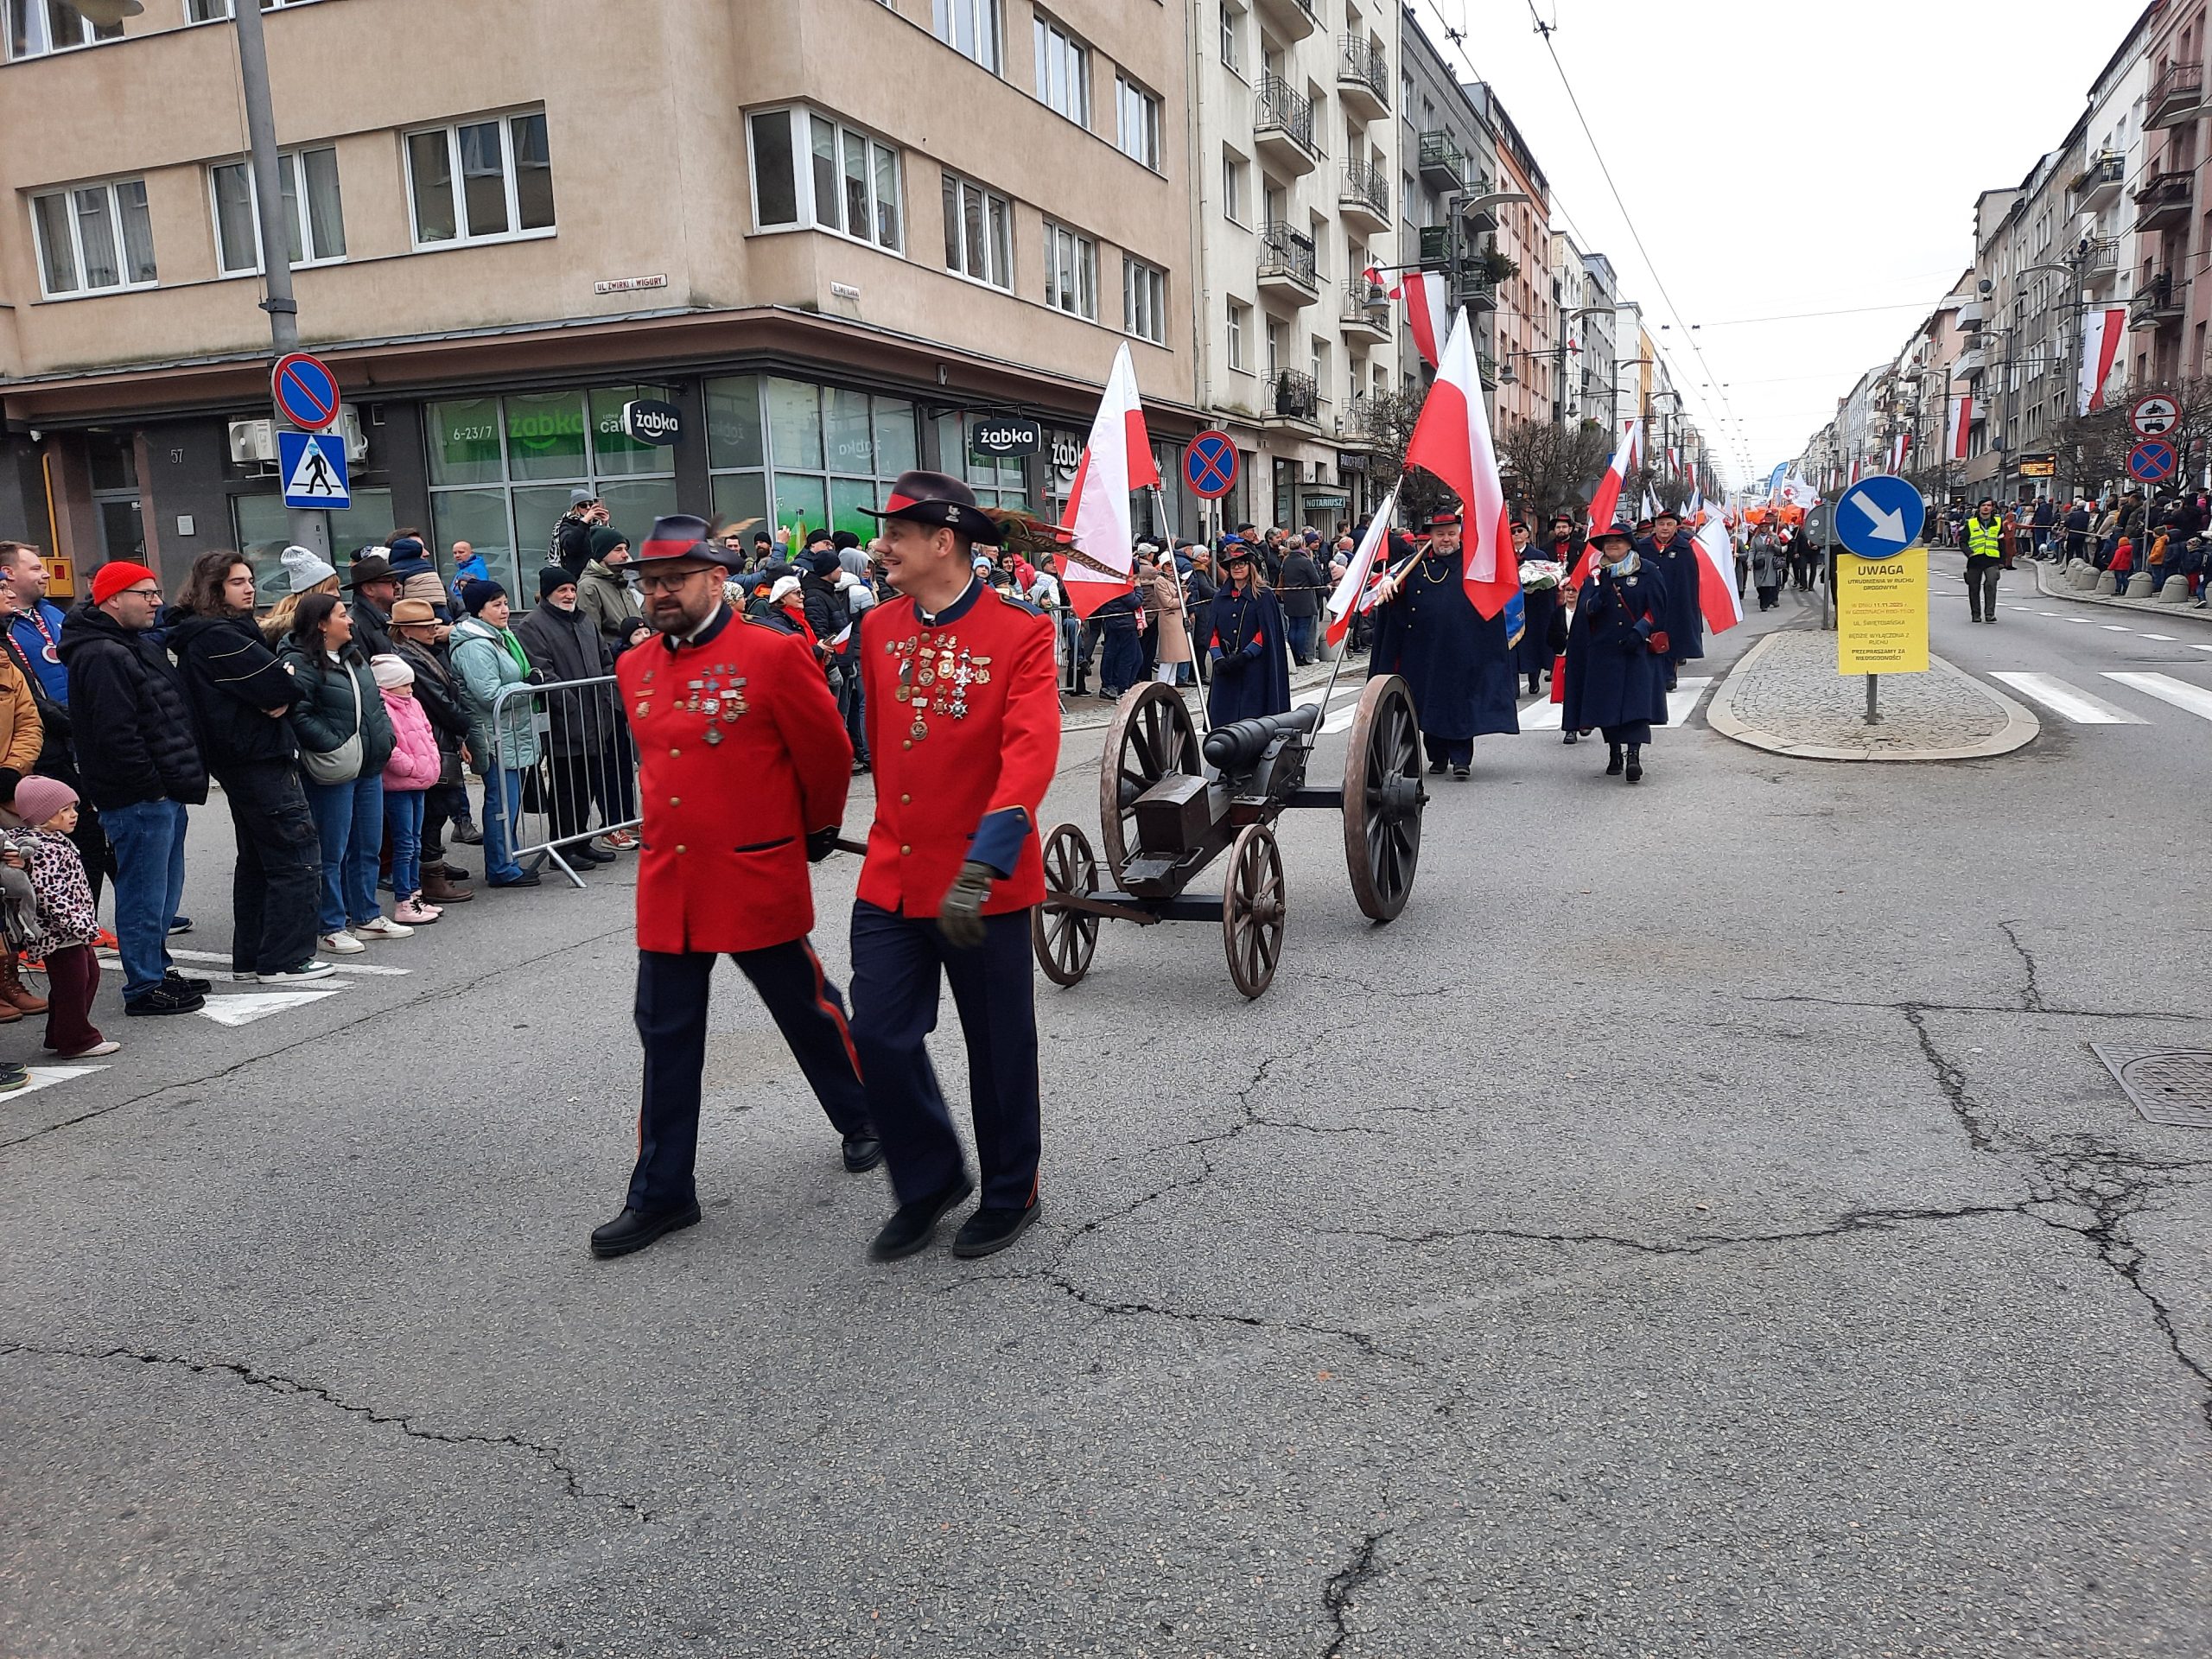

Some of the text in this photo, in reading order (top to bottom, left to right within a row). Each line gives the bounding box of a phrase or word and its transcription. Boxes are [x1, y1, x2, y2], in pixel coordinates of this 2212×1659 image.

[636, 276, 662, 287] WIGURY
[600, 415, 625, 434] caf
[635, 409, 679, 431] żabka
[454, 425, 493, 441] 6-23/7
[980, 428, 1033, 443] żabka
[170, 448, 183, 464] 57
[1051, 435, 1085, 467] żabk
[1306, 499, 1342, 507] NOTARIUSZ
[1858, 565, 1904, 575] UWAGA
